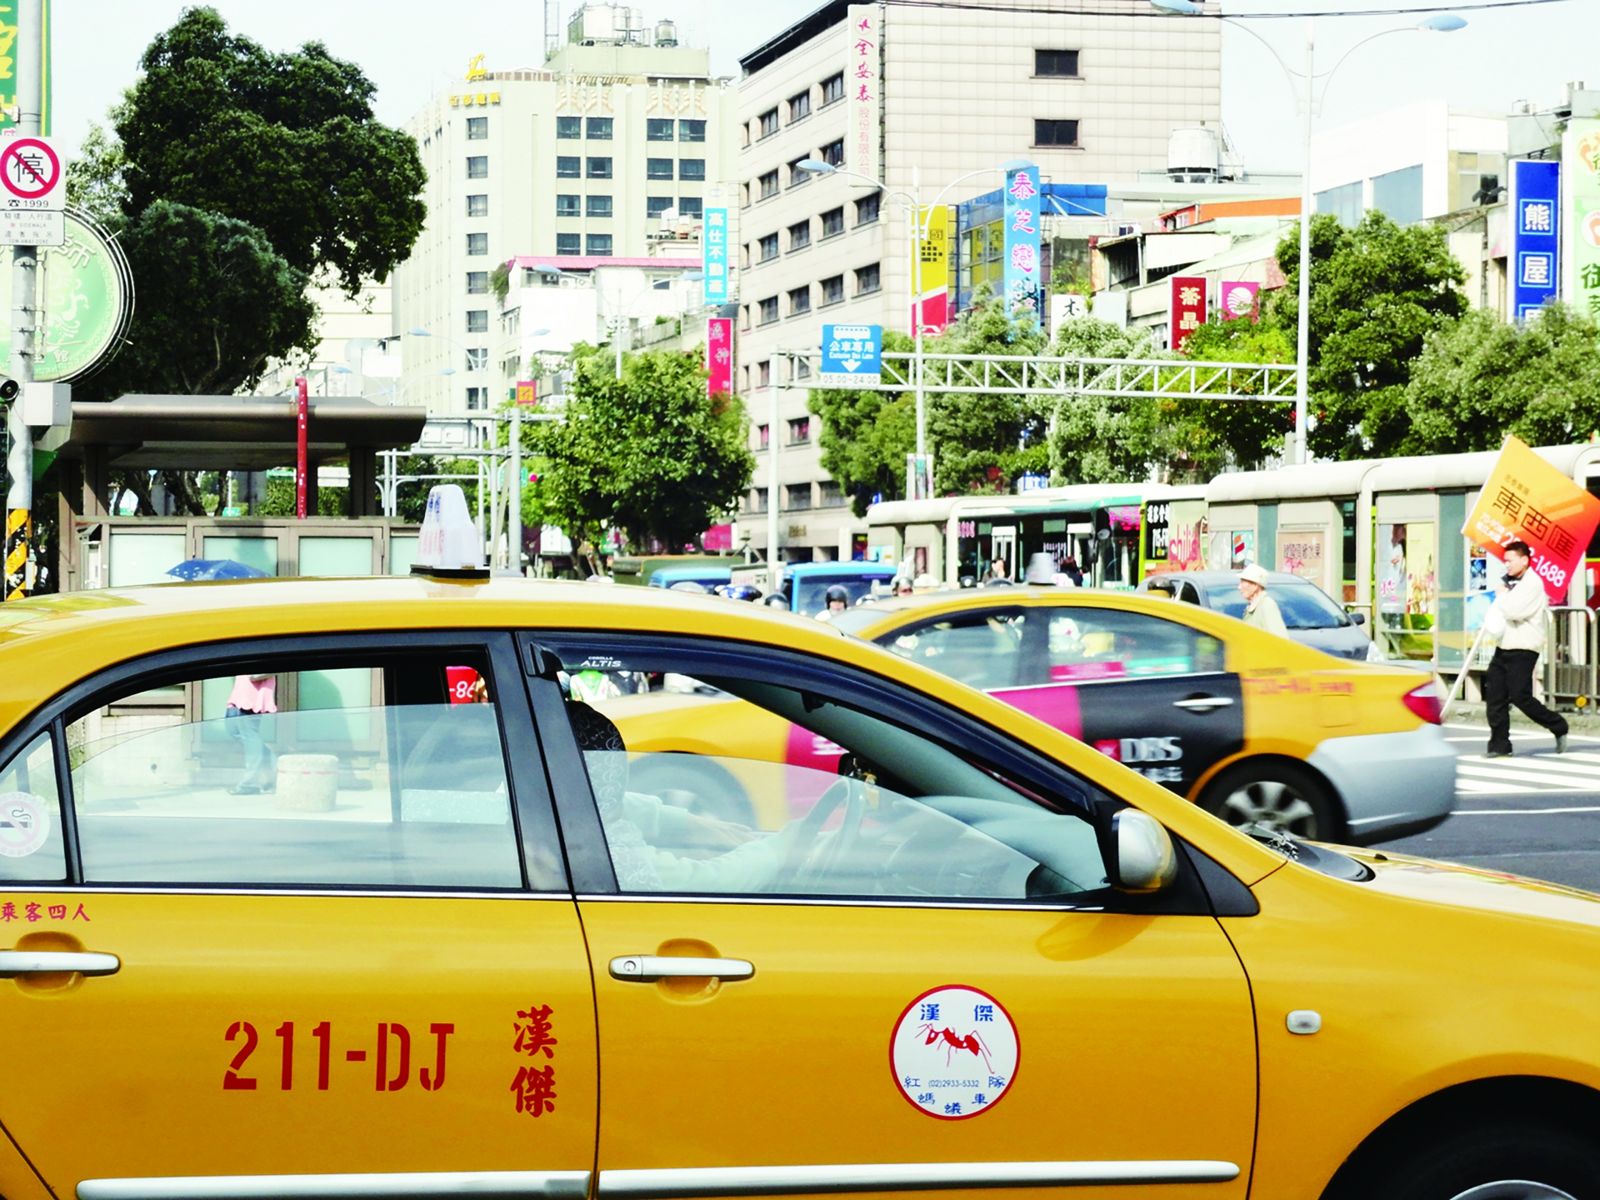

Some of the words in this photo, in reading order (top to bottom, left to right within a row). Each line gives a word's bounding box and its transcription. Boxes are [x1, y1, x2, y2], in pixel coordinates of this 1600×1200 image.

[14, 153, 44, 184] 停
[23, 200, 49, 208] 1999
[580, 660, 622, 668] ALTIS
[0, 902, 91, 922] 乘客四人
[223, 1021, 455, 1091] 211-DJ
[510, 1004, 558, 1118] 漢傑
